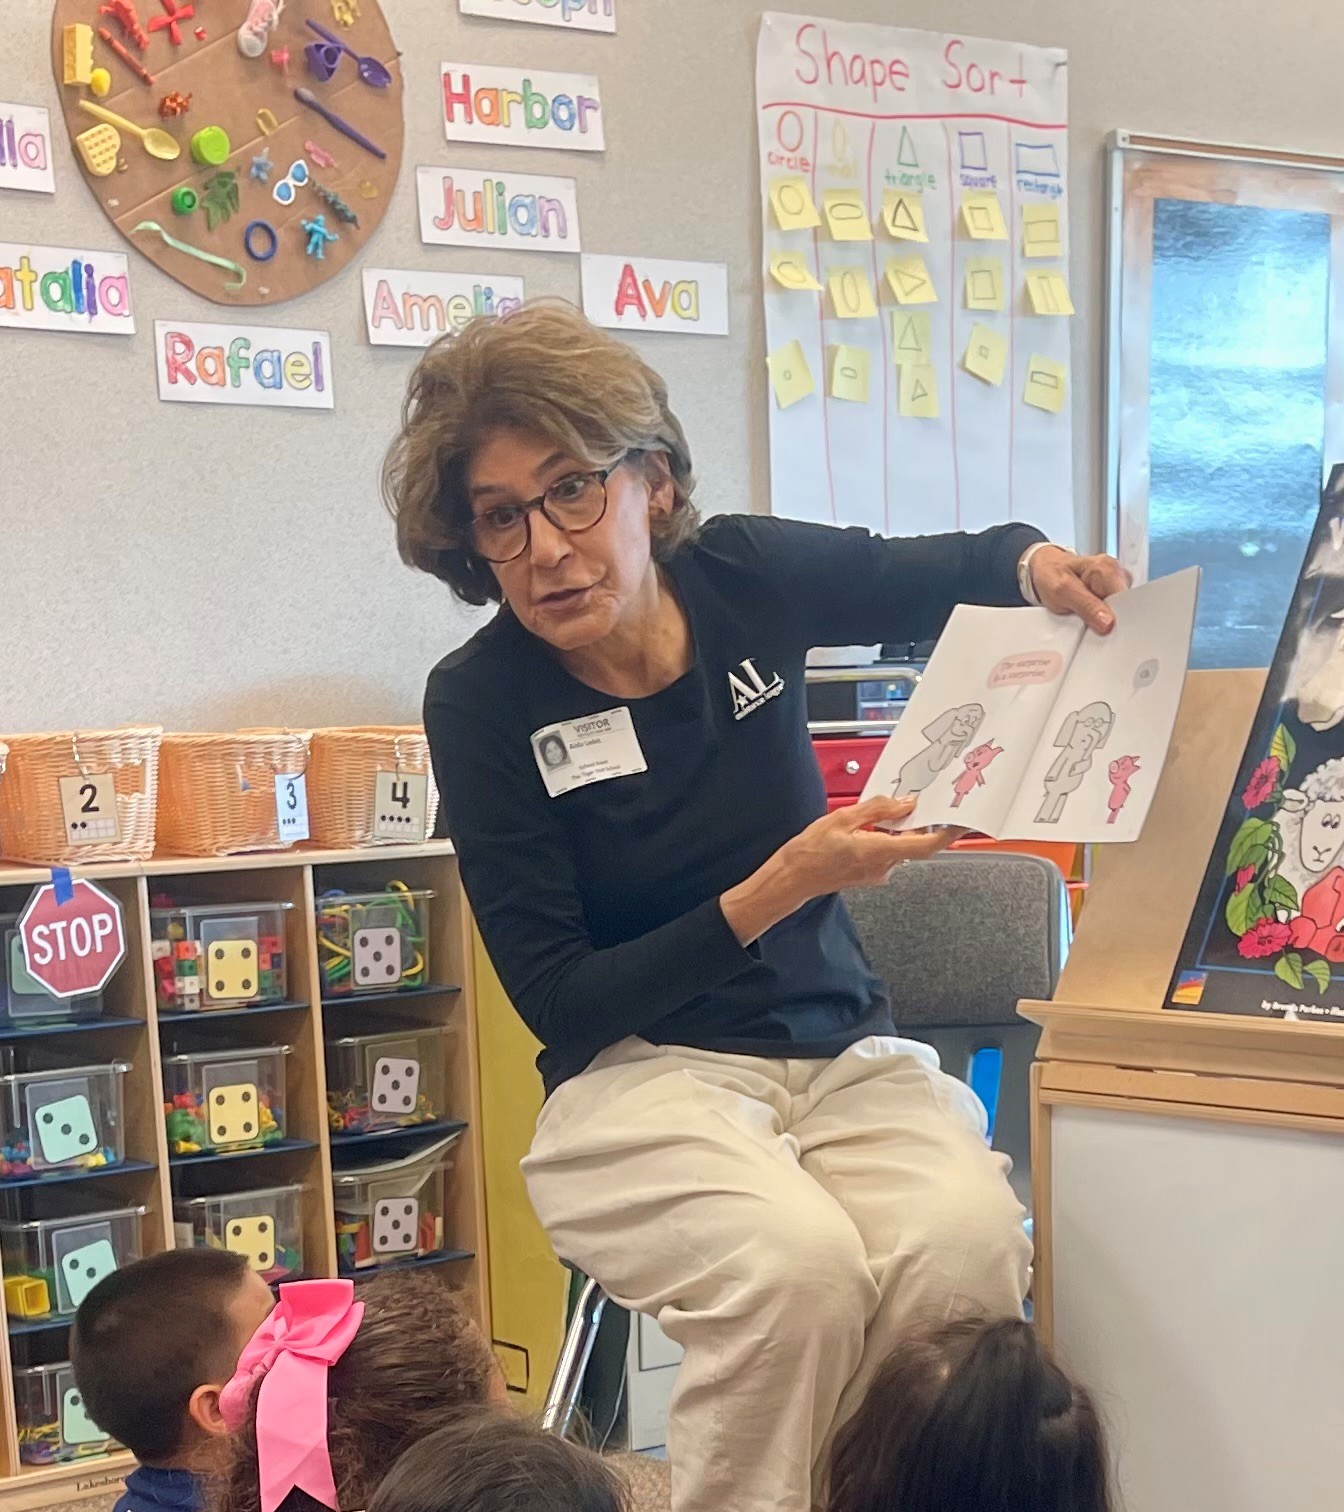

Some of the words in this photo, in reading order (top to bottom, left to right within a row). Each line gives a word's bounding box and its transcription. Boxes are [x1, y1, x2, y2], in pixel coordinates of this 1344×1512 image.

[794, 23, 910, 102] Shape
[942, 39, 1028, 99] Sort
[442, 70, 599, 134] Harbor
[432, 174, 567, 239] Julian
[613, 263, 700, 322] Ava
[164, 331, 325, 392] Rafael
[79, 783, 100, 814] 2
[285, 782, 297, 810] 3
[390, 782, 411, 809] 4
[31, 913, 114, 965] STOP
